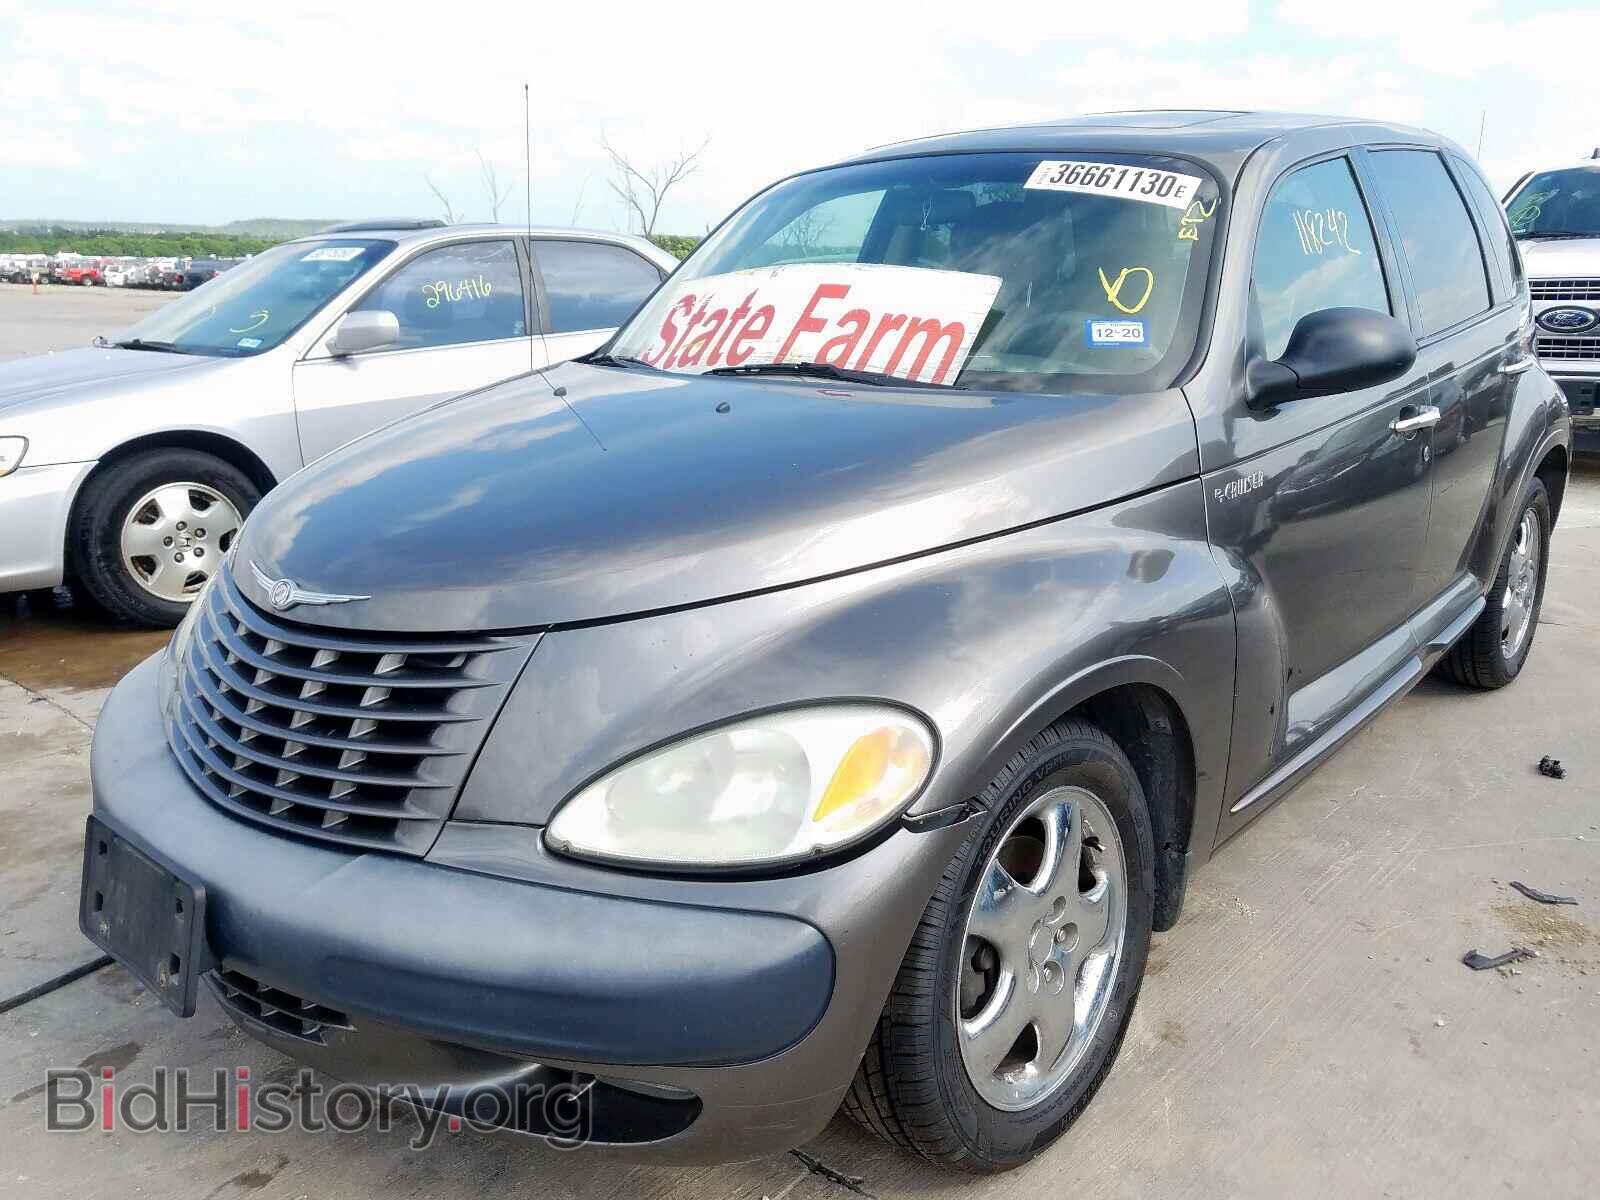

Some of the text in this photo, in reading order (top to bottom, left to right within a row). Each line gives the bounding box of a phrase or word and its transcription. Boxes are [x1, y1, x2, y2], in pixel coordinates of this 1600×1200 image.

[422, 275, 491, 308] 296416
[642, 283, 966, 384] State Farm
[1096, 328, 1141, 338] 12-20
